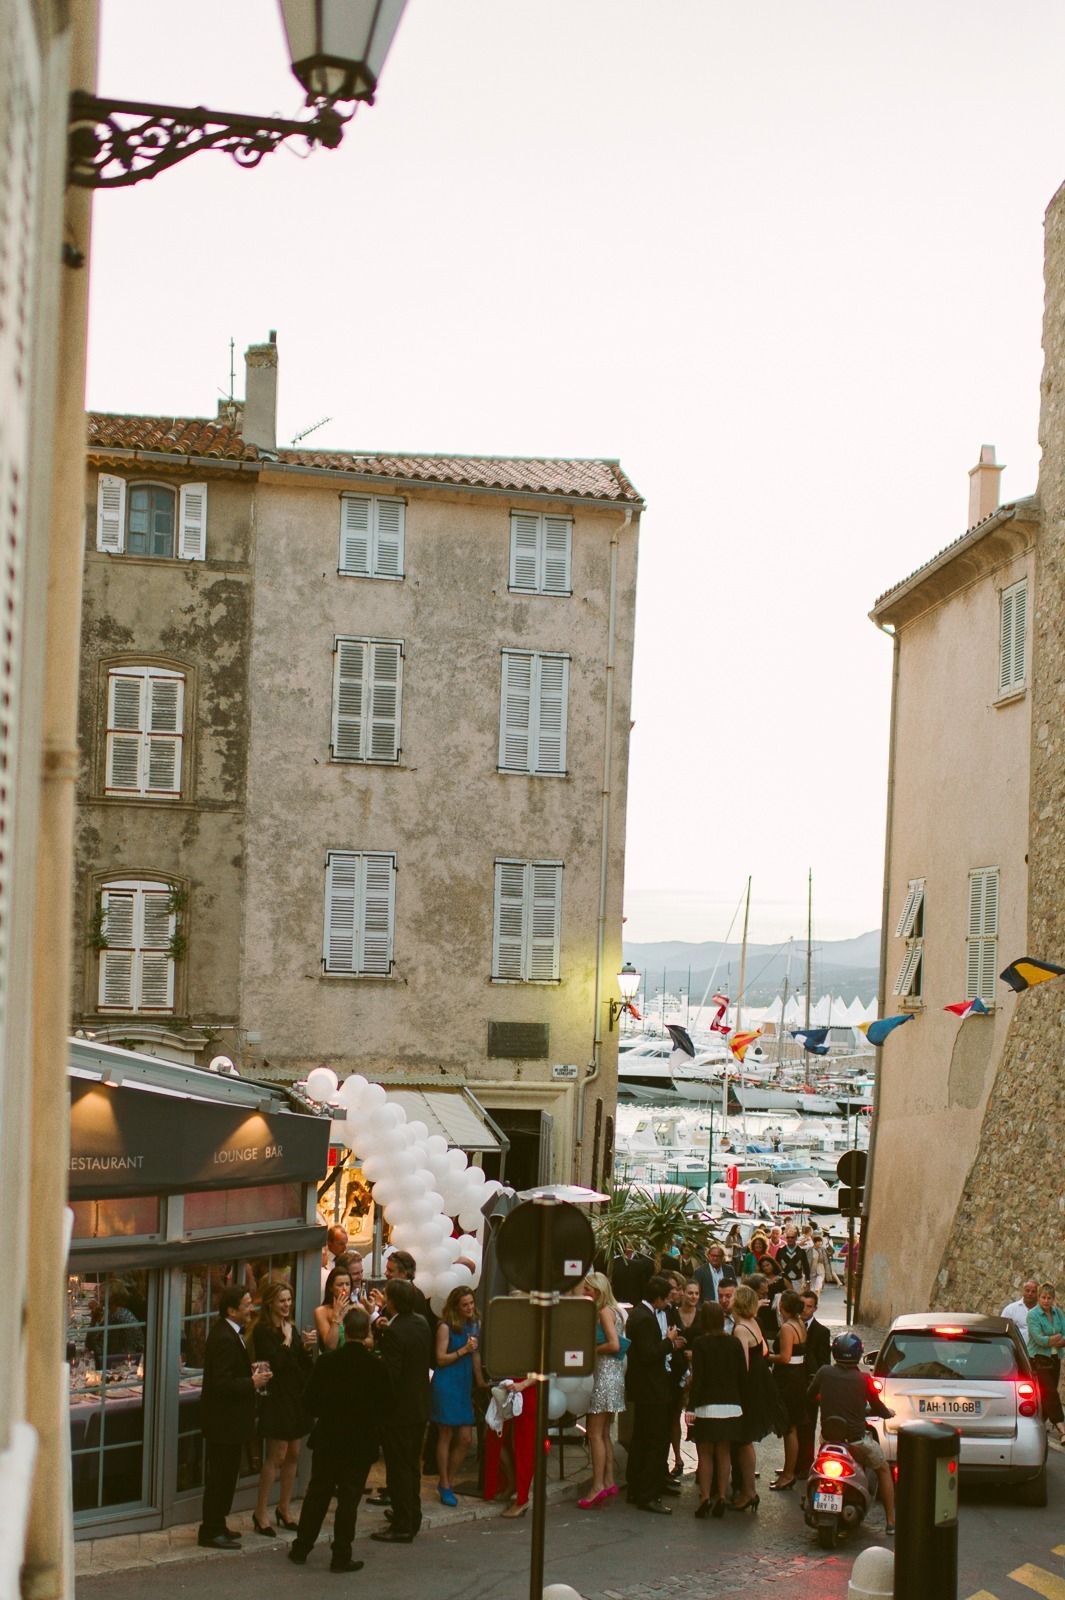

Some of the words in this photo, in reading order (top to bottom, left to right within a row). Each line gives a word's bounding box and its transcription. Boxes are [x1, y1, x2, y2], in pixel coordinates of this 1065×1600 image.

[214, 1148, 258, 1164] LOUNGE
[265, 1145, 283, 1159] BAR
[68, 1156, 144, 1170] ESTAURANT
[823, 1494, 835, 1502] 215
